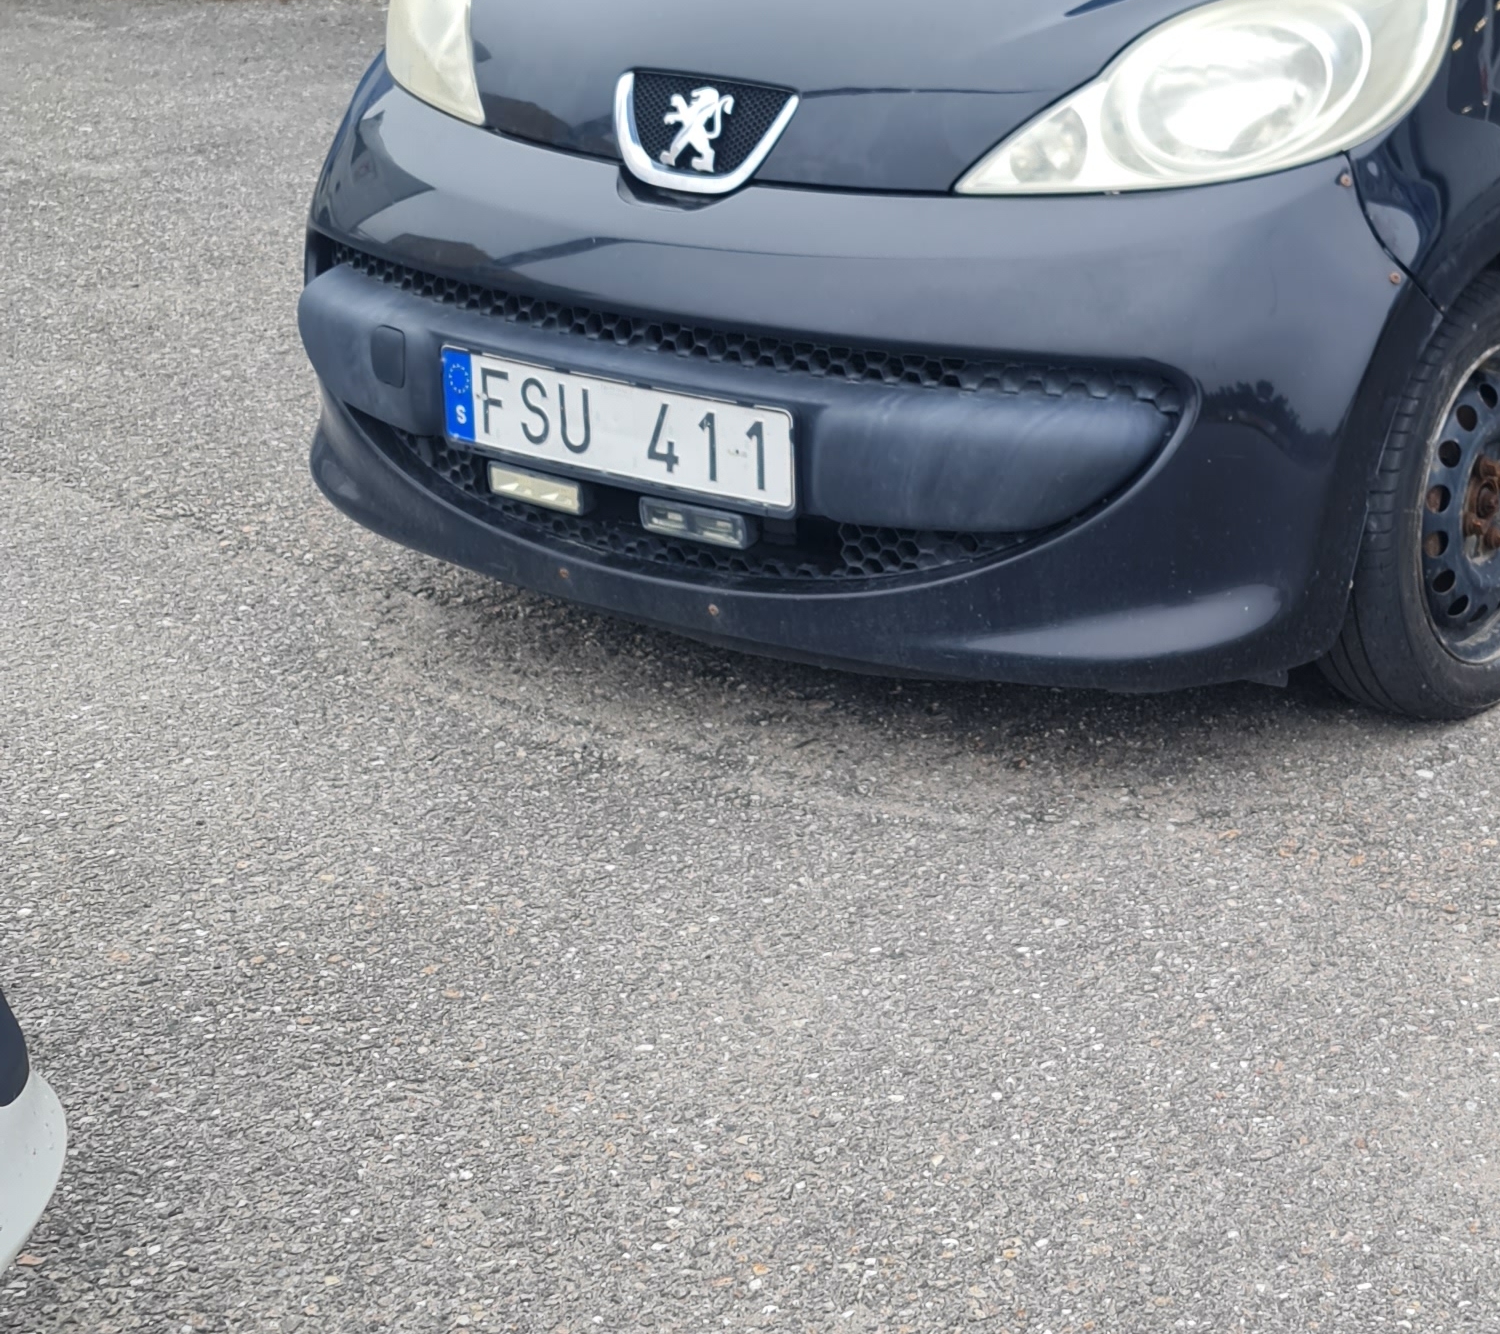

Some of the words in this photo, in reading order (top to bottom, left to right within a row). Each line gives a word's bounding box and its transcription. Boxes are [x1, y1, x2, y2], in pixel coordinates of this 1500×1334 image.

[456, 404, 467, 424] S
[481, 367, 592, 454] FSU
[648, 403, 766, 491] 411
